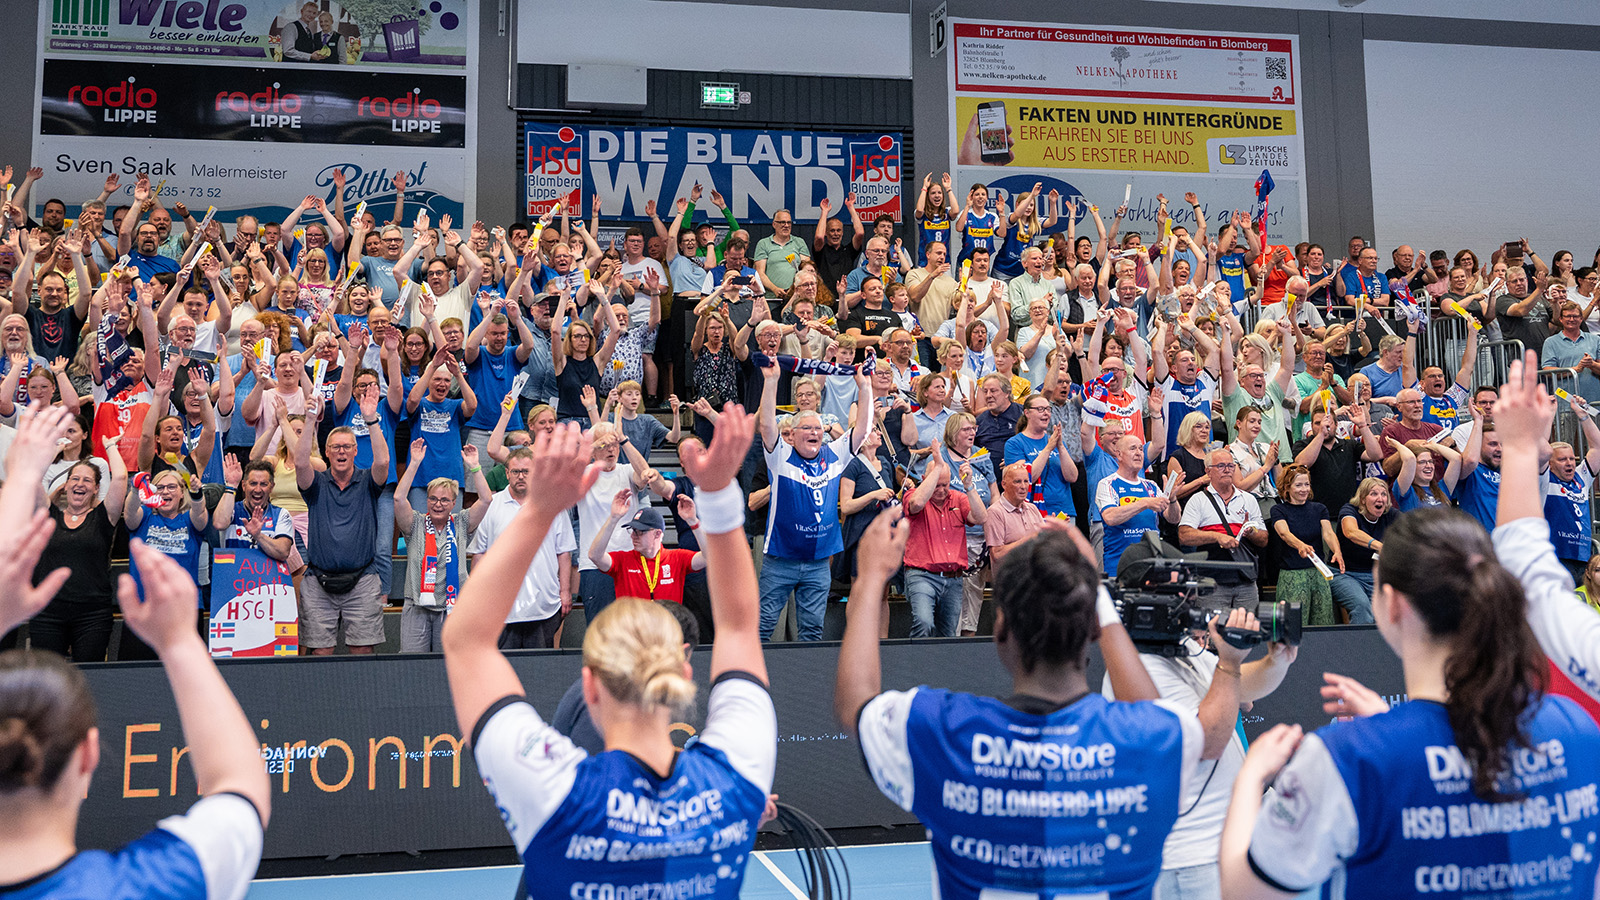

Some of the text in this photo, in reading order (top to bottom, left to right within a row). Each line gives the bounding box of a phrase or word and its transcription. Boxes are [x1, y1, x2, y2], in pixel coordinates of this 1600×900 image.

[118, 0, 248, 32] Wiele
[149, 27, 260, 45] besser einkaufen
[936, 19, 945, 50] D
[979, 27, 1268, 51] Ihr Partner für Gesundheit und Wohlbefinden in Blomberg
[963, 72, 1047, 81] www.nelken-apotheke.de
[1075, 66, 1179, 80] NELKEN APOTHEKE
[68, 76, 157, 108] radio
[215, 82, 301, 113] radio
[357, 88, 441, 119] radio
[104, 108, 157, 123] LIPPE
[250, 114, 301, 128] LIPPE
[1019, 107, 1283, 130] FAKTEN UND HINTERGRÜNDE
[391, 119, 441, 133] LIPPE
[1020, 125, 1194, 146] ERFAHREN SIE BEI UNS
[589, 130, 845, 166] DIE BLAUE
[1043, 146, 1194, 165] AUS ERSTER HAND.
[1248, 145, 1288, 153] LIPPISCHE
[56, 154, 287, 180] Sven Saak Malermeister
[528, 145, 581, 175] HSG
[851, 154, 899, 182] HSG
[1248, 158, 1289, 167] ZEITUNG
[315, 161, 429, 206] Potthst
[528, 174, 581, 189] Blomberg
[589, 161, 845, 219] WAND
[851, 182, 900, 196] Blomberg
[189, 187, 203, 197] 73
[206, 187, 221, 198] 52
[528, 186, 556, 200] Lippe
[935, 231, 942, 242] 8
[973, 238, 988, 248] 80
[1120, 417, 1133, 432] 18
[813, 490, 824, 506] 9
[1572, 503, 1583, 517] 8
[237, 558, 273, 576] Auf
[233, 575, 288, 597] geht's
[227, 598, 274, 621] HSG!
[971, 725, 1117, 770] DMVStore
[974, 764, 1009, 778] YOUR
[1012, 767, 1043, 781] LINK
[942, 779, 1149, 817] HSG BLOMBERG-LIPPE
[1402, 805, 1447, 840] HSG
